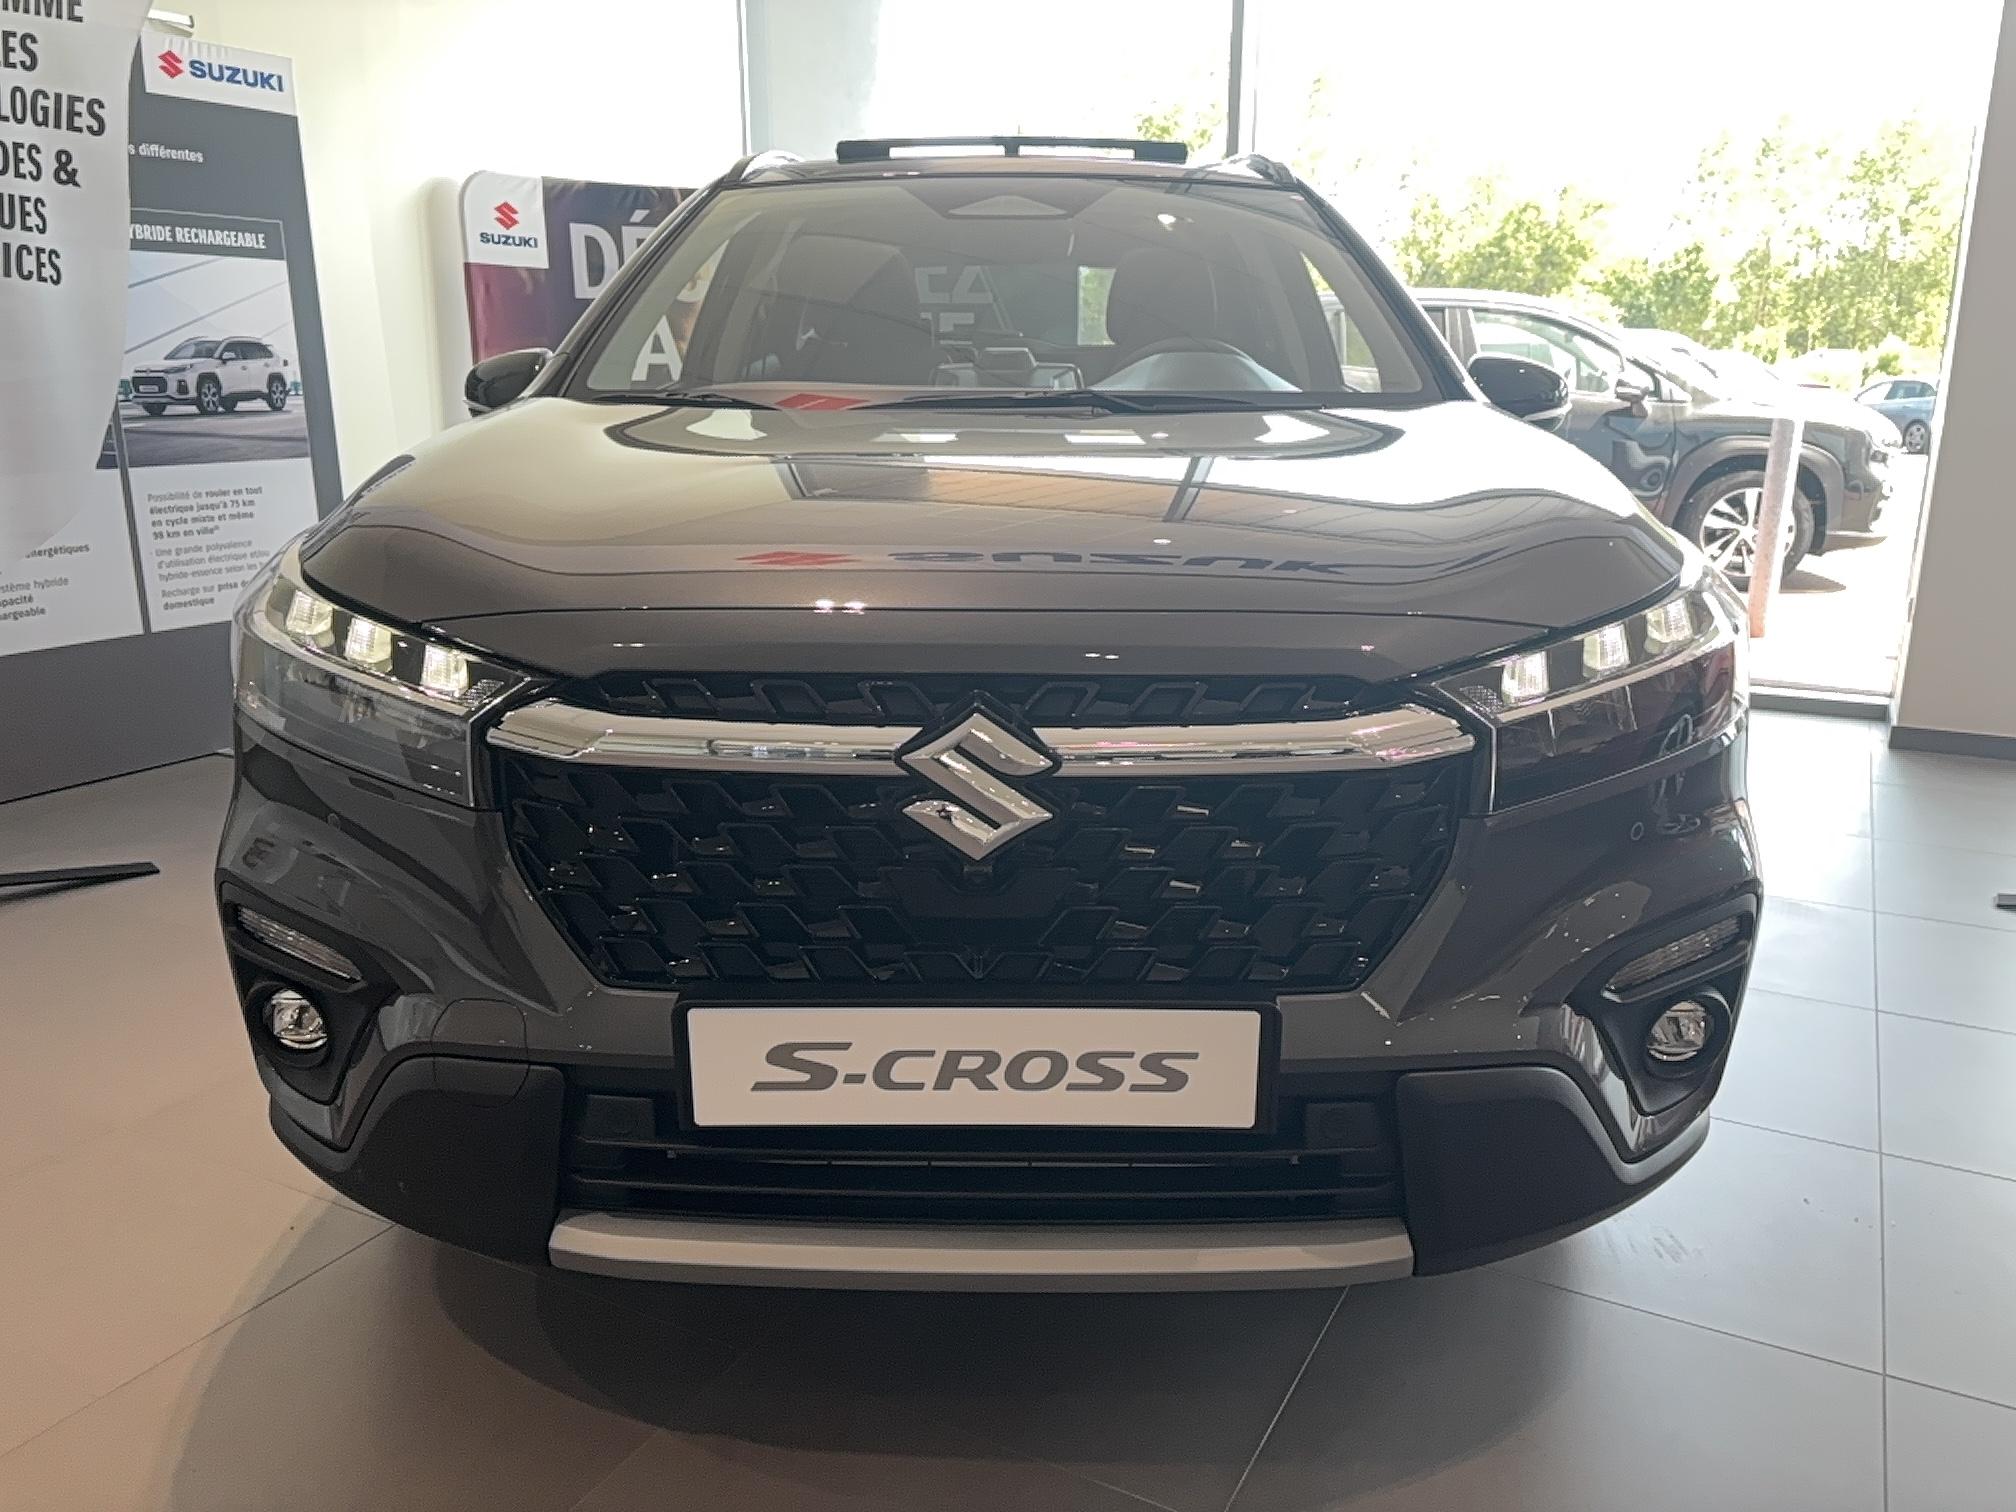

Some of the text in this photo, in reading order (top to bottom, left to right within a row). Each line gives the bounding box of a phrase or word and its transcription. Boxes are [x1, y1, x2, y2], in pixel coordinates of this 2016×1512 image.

[0, 30, 38, 72] ES
[188, 59, 285, 92] SUZUKI
[138, 143, 205, 163] différentes
[53, 149, 82, 188] &
[175, 226, 267, 249] RECHARGEABLE
[480, 231, 538, 249] SUZUKI
[2, 242, 62, 286] ICES
[245, 486, 263, 495] tout
[242, 499, 256, 508] km
[165, 516, 188, 528] cycle
[166, 529, 181, 539] km
[183, 528, 194, 537] en
[0, 594, 33, 608] pacité
[163, 597, 215, 611] domestique
[750, 1042, 1199, 1092] S-CROSS
